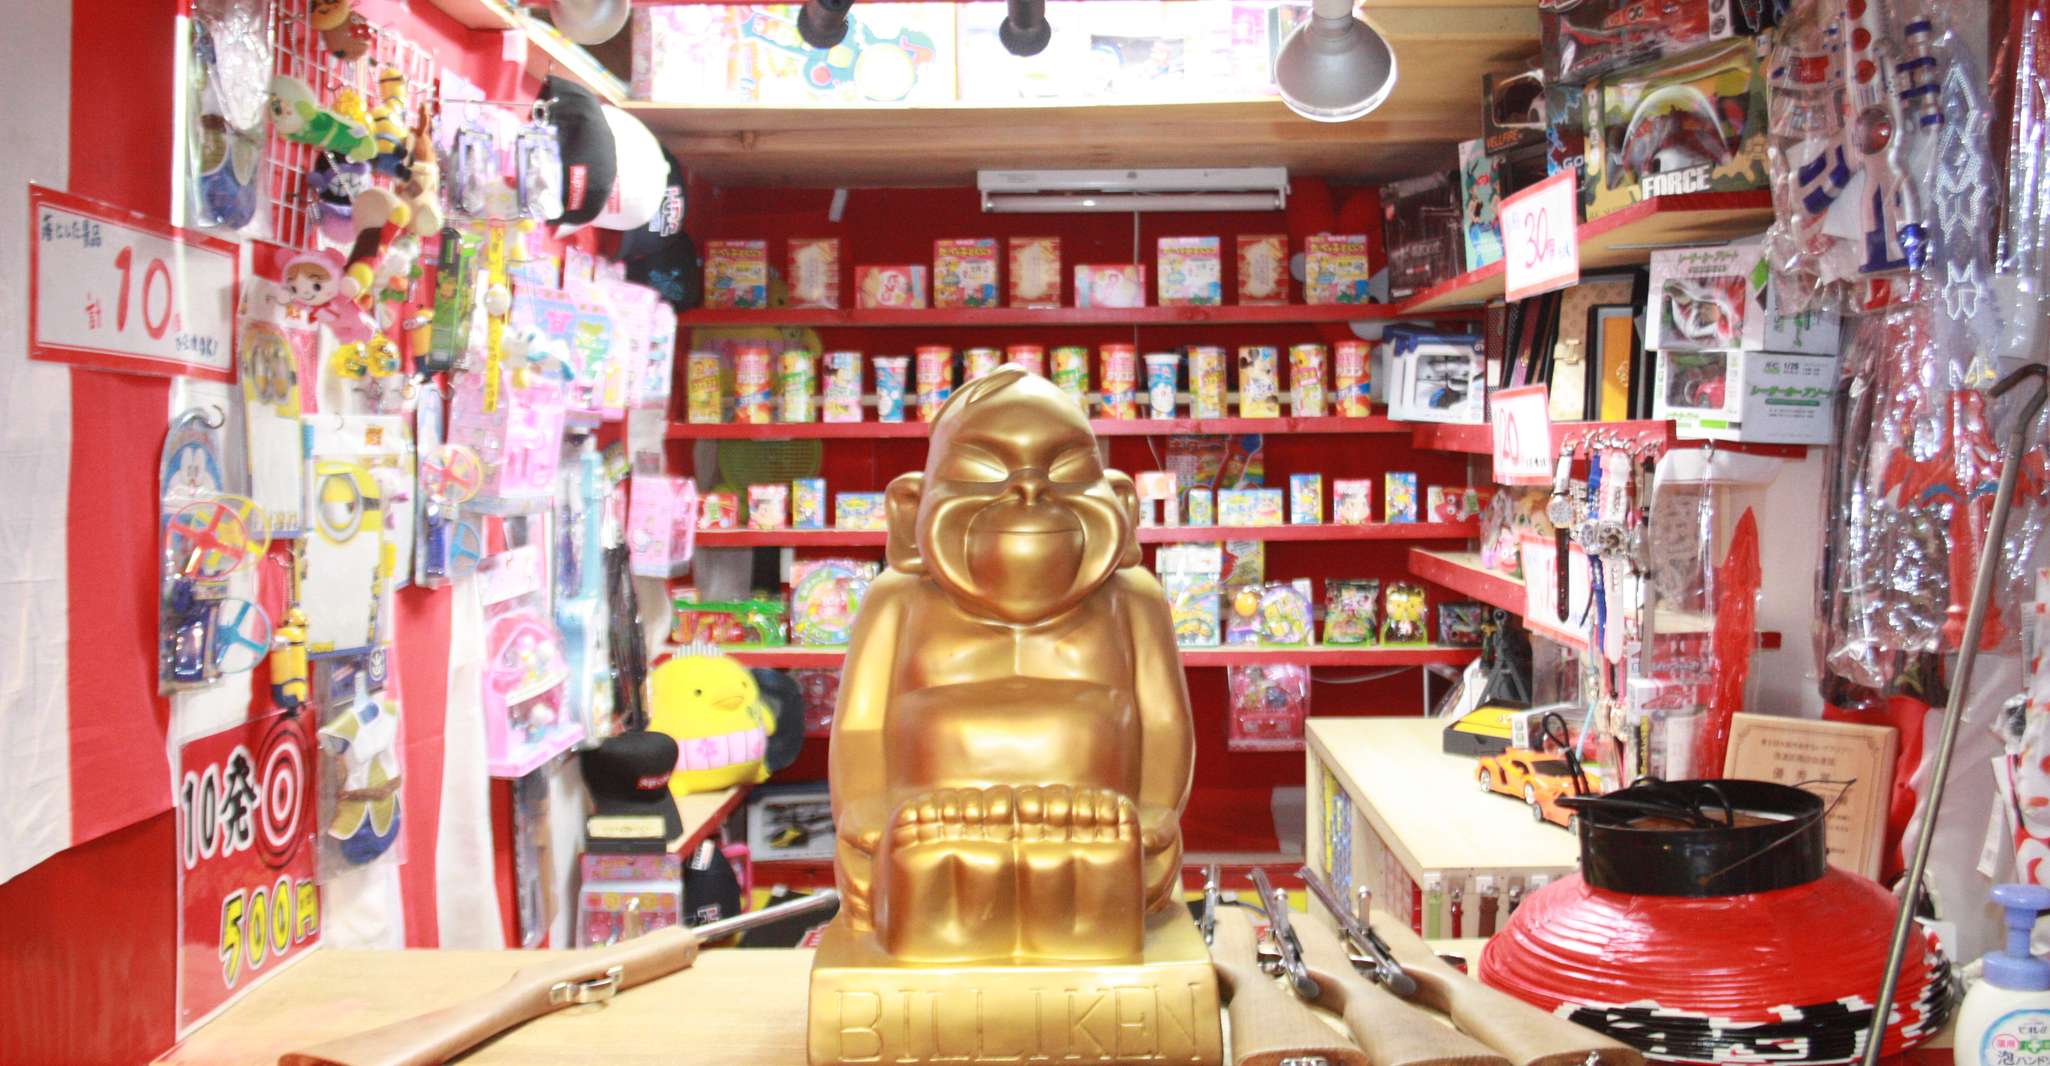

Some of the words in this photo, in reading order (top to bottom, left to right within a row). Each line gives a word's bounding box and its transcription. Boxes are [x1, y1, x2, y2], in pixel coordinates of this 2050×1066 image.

[1642, 165, 1711, 200] FORCE
[114, 246, 172, 340] 10
[181, 745, 261, 869] 10発
[219, 875, 319, 988] 500円
[834, 982, 1201, 1063] BILLIKEN
